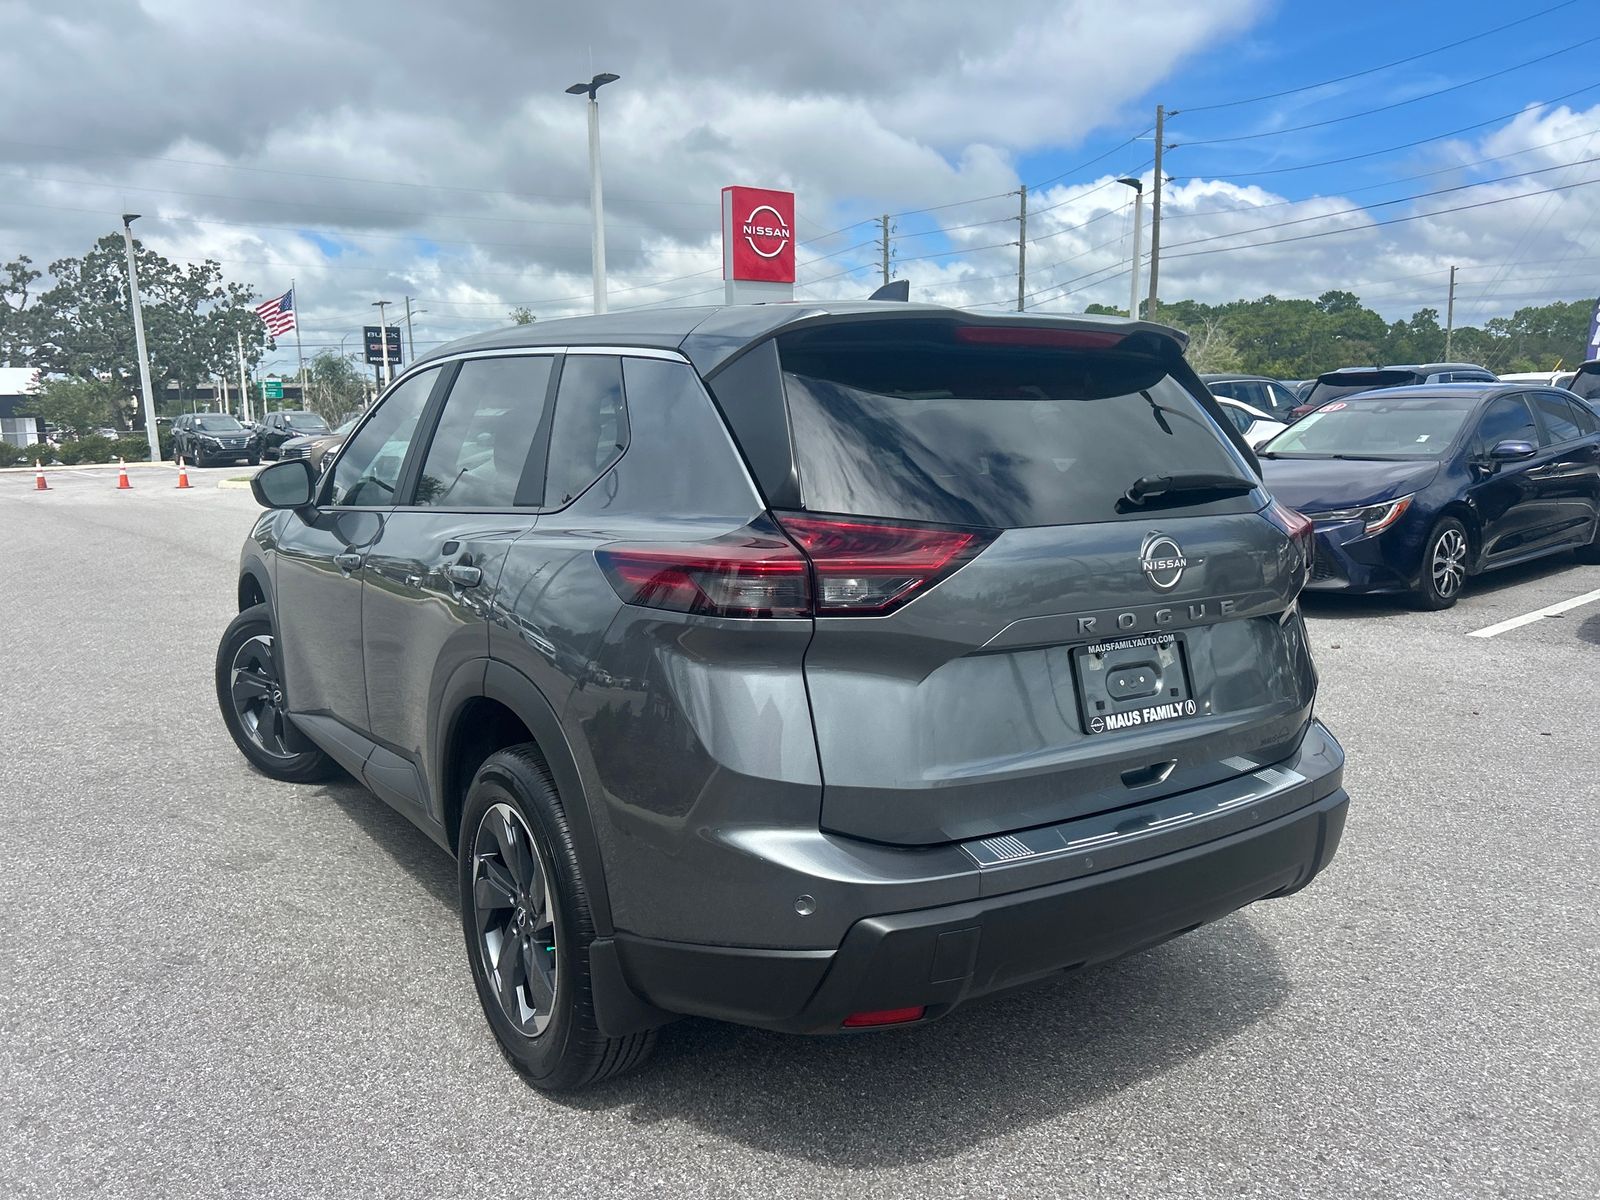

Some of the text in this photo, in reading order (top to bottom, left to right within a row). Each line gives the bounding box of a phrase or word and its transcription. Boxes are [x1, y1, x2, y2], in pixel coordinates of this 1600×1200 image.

[743, 225, 790, 238] NISSAN
[1143, 558, 1187, 571] NISSAN
[1077, 600, 1236, 634] ROGUE
[1087, 633, 1175, 654] MAUSFAMILYAUTO.COM
[1105, 702, 1184, 731] MAUS FAMILY
